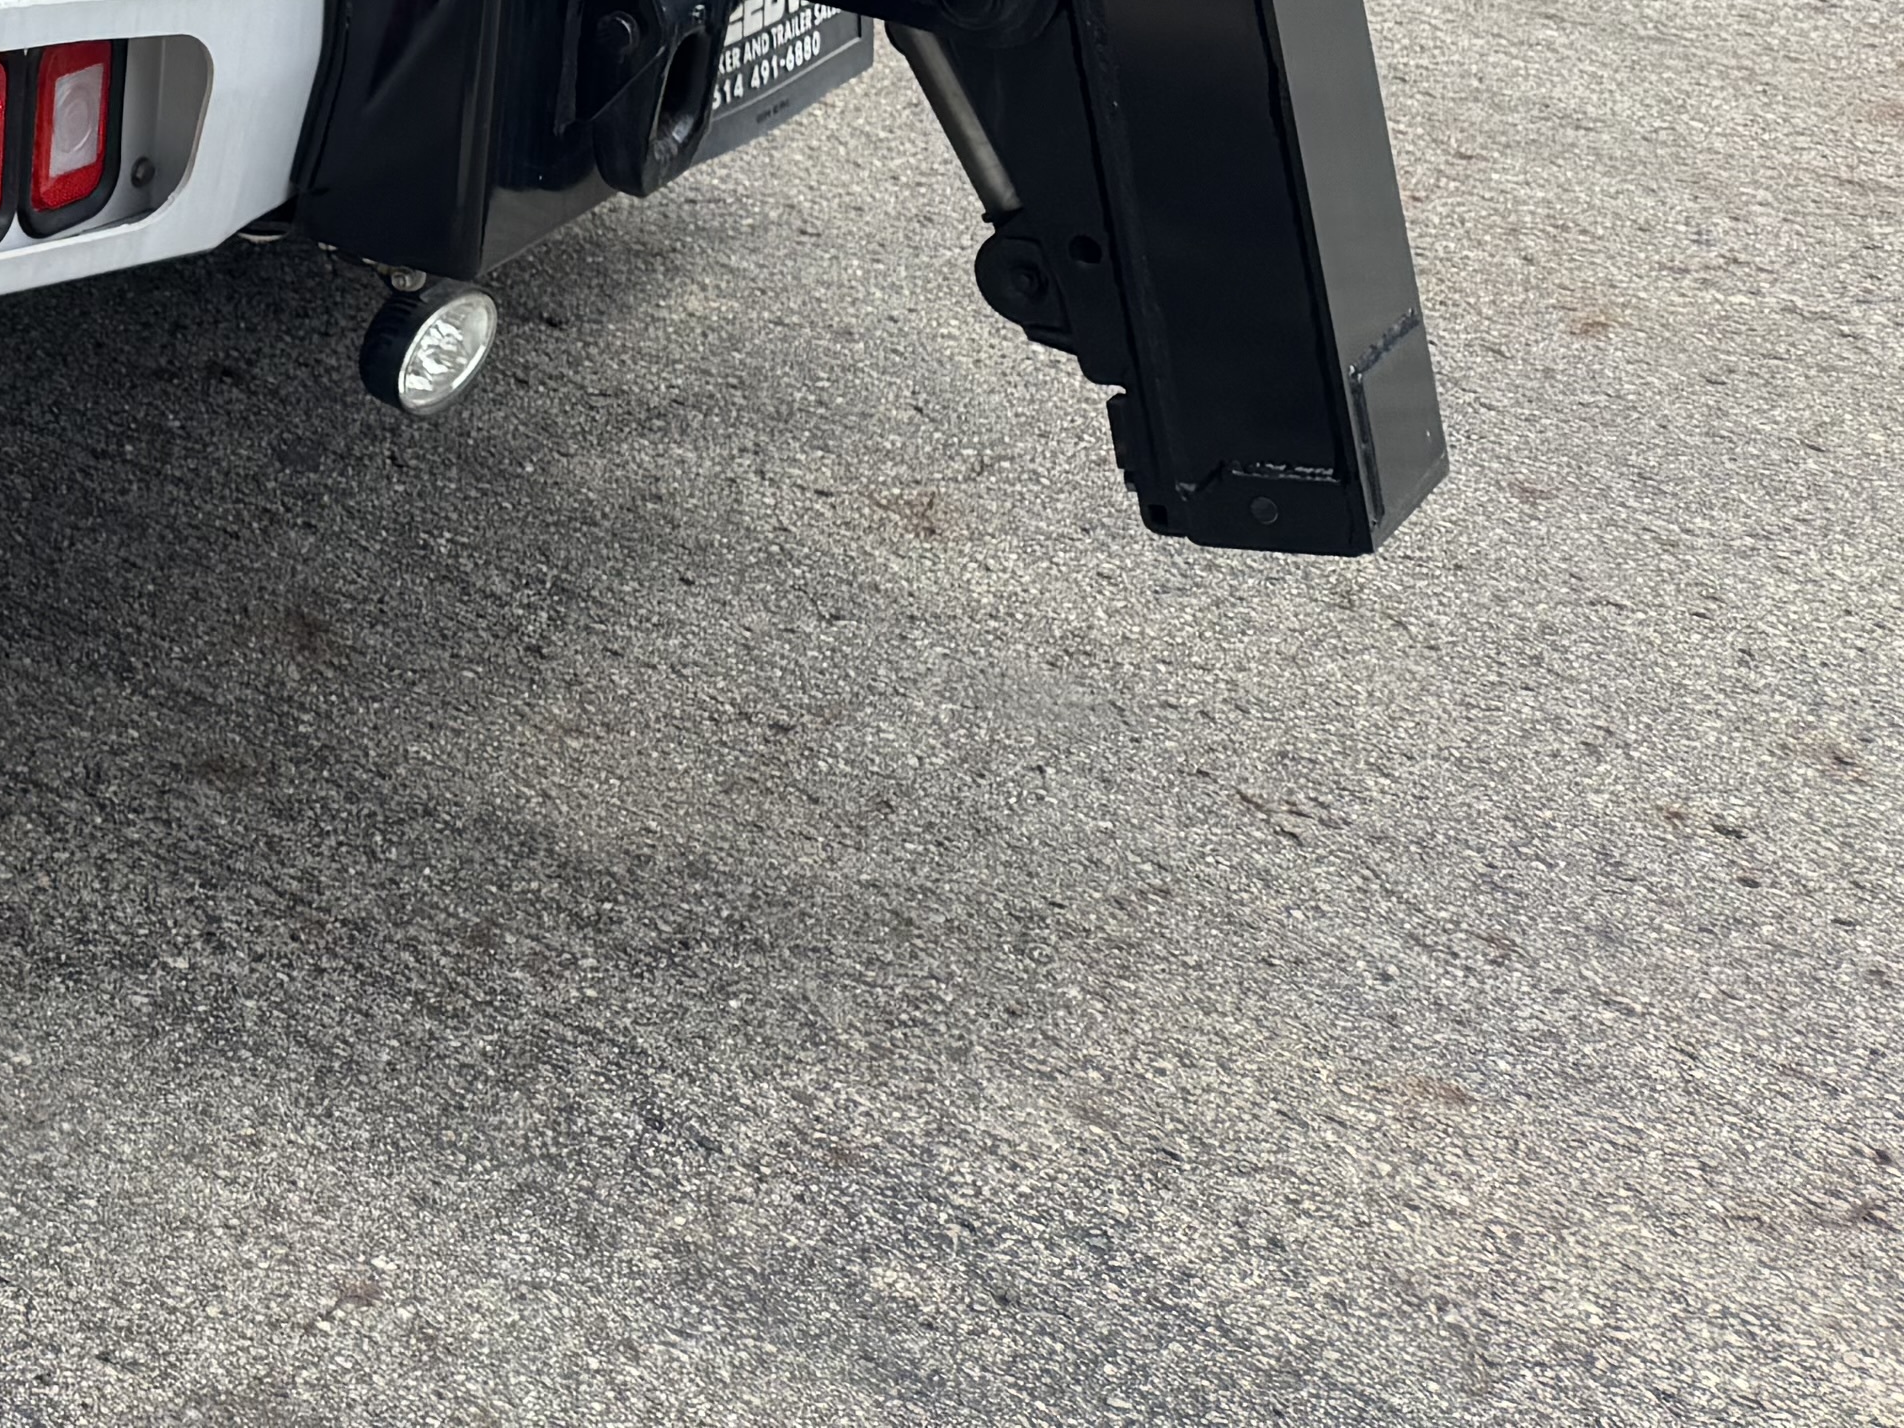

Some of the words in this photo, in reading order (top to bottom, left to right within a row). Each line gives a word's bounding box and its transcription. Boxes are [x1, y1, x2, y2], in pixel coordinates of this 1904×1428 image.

[743, 32, 770, 65] AND
[771, 8, 812, 49] TRAILER
[750, 30, 821, 88] 491-6880
